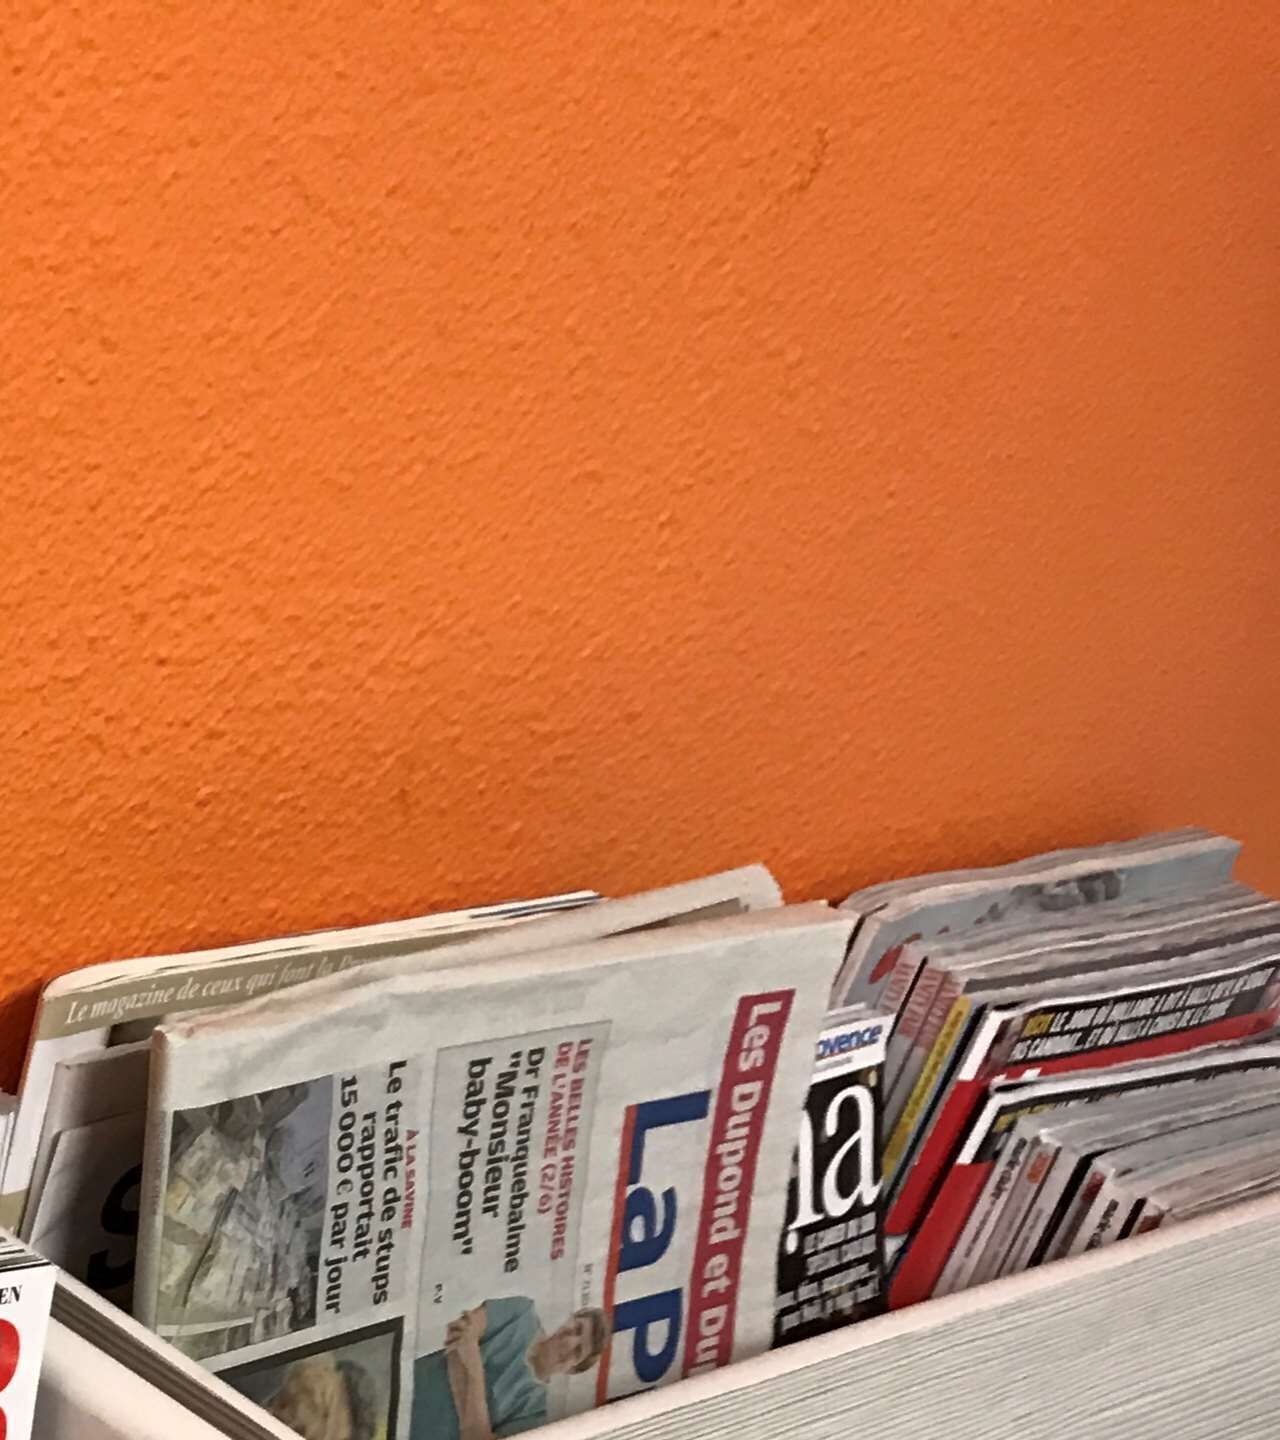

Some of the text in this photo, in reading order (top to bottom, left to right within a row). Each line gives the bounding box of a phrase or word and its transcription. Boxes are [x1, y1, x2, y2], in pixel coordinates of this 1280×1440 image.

[64, 1001, 88, 1025] Le
[90, 984, 171, 1018] magazine
[176, 976, 199, 1001] de
[202, 976, 243, 996] ceux
[245, 967, 277, 995] qui
[554, 1040, 574, 1071] DE
[735, 1001, 783, 1073] Les
[404, 1143, 418, 1163] LA
[504, 1046, 546, 1274] Dr Franquebalme
[549, 1037, 593, 1262] LES BELLES HISTOIRES
[706, 1080, 765, 1245] Dupond
[351, 1111, 381, 1263] rapportait
[371, 1060, 408, 1306] Le trafic de stups
[400, 1165, 416, 1230] SAVINE
[329, 1203, 351, 1249] par
[323, 1256, 346, 1314] jour
[700, 1254, 730, 1299] et
